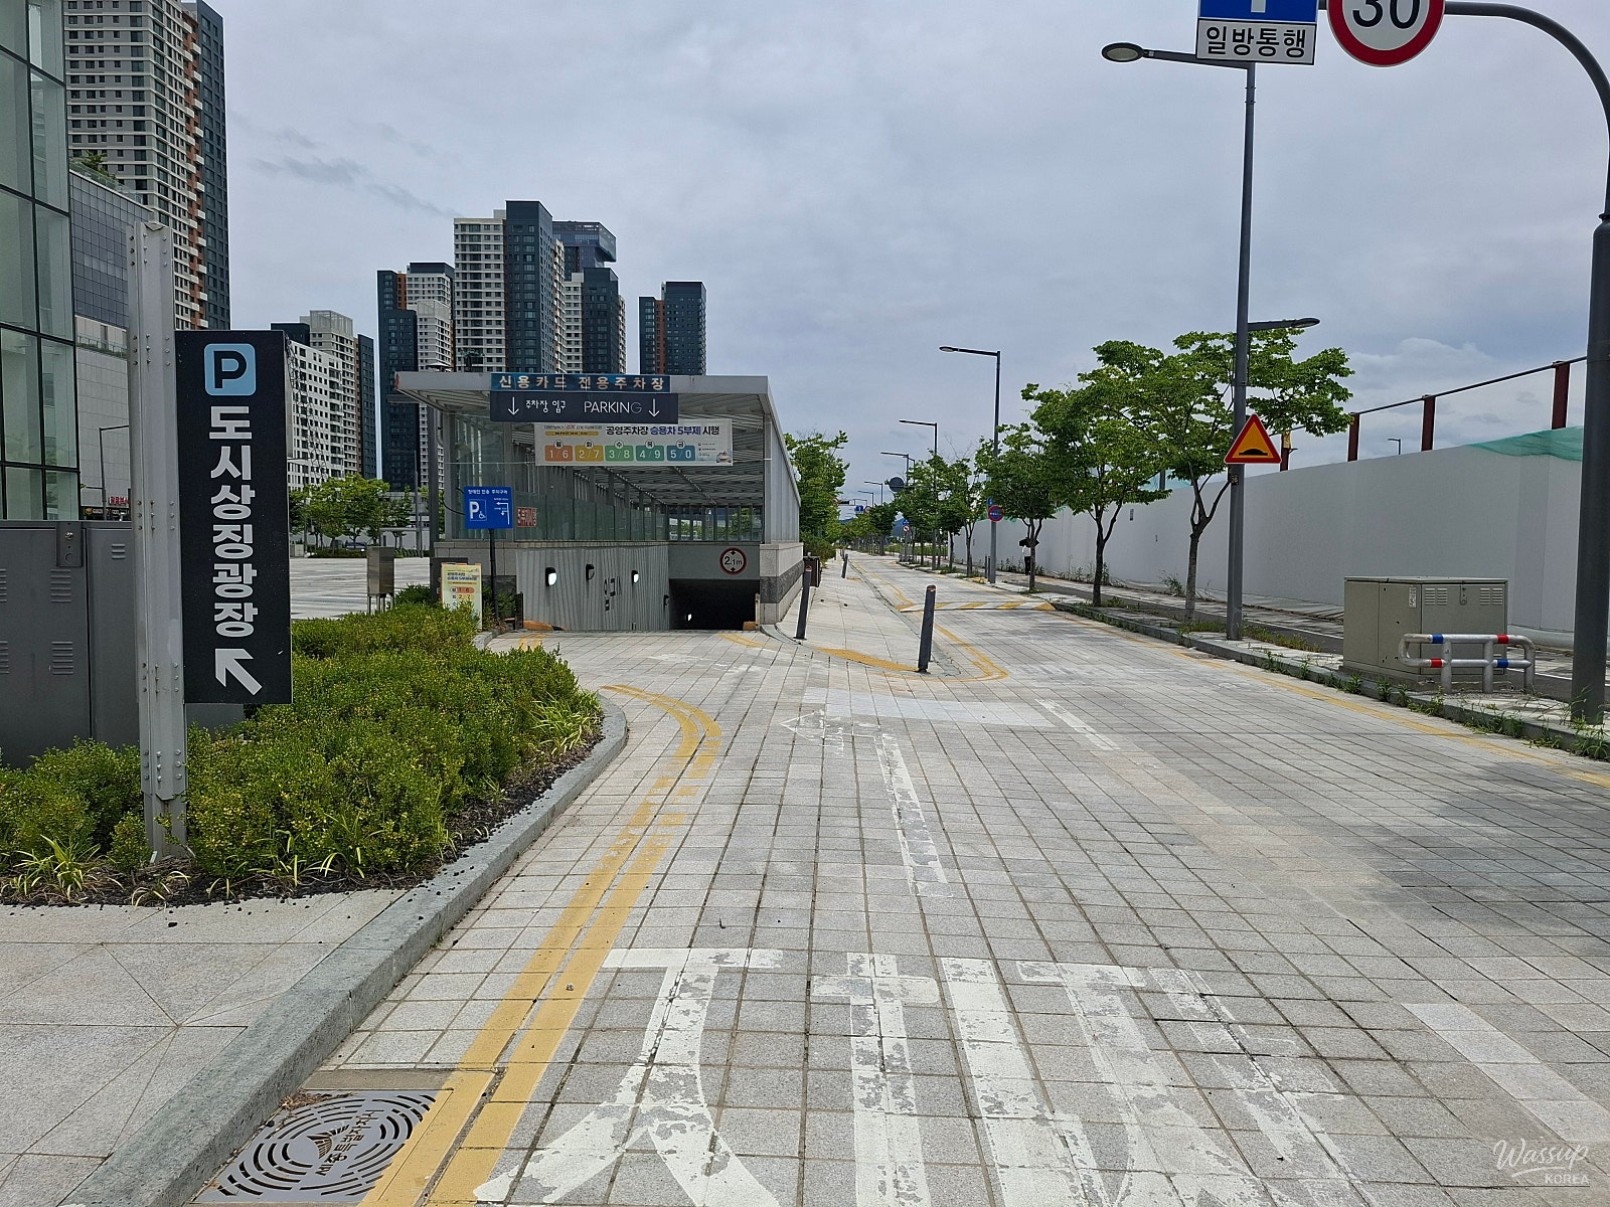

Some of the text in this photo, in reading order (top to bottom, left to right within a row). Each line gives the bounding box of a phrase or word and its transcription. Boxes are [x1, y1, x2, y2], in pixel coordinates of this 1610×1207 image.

[1353, 0, 1421, 29] 30
[1206, 26, 1306, 58] 일방통행
[213, 351, 248, 389] P
[499, 375, 665, 391] 신용카드 전용주차장
[525, 399, 642, 414] 주차장 입구 PARKING
[606, 425, 649, 436] 공영주차장
[650, 425, 677, 436] 승용차
[677, 425, 701, 436] 5부제
[702, 425, 720, 436] 시행
[208, 405, 259, 638] 도시상징광장
